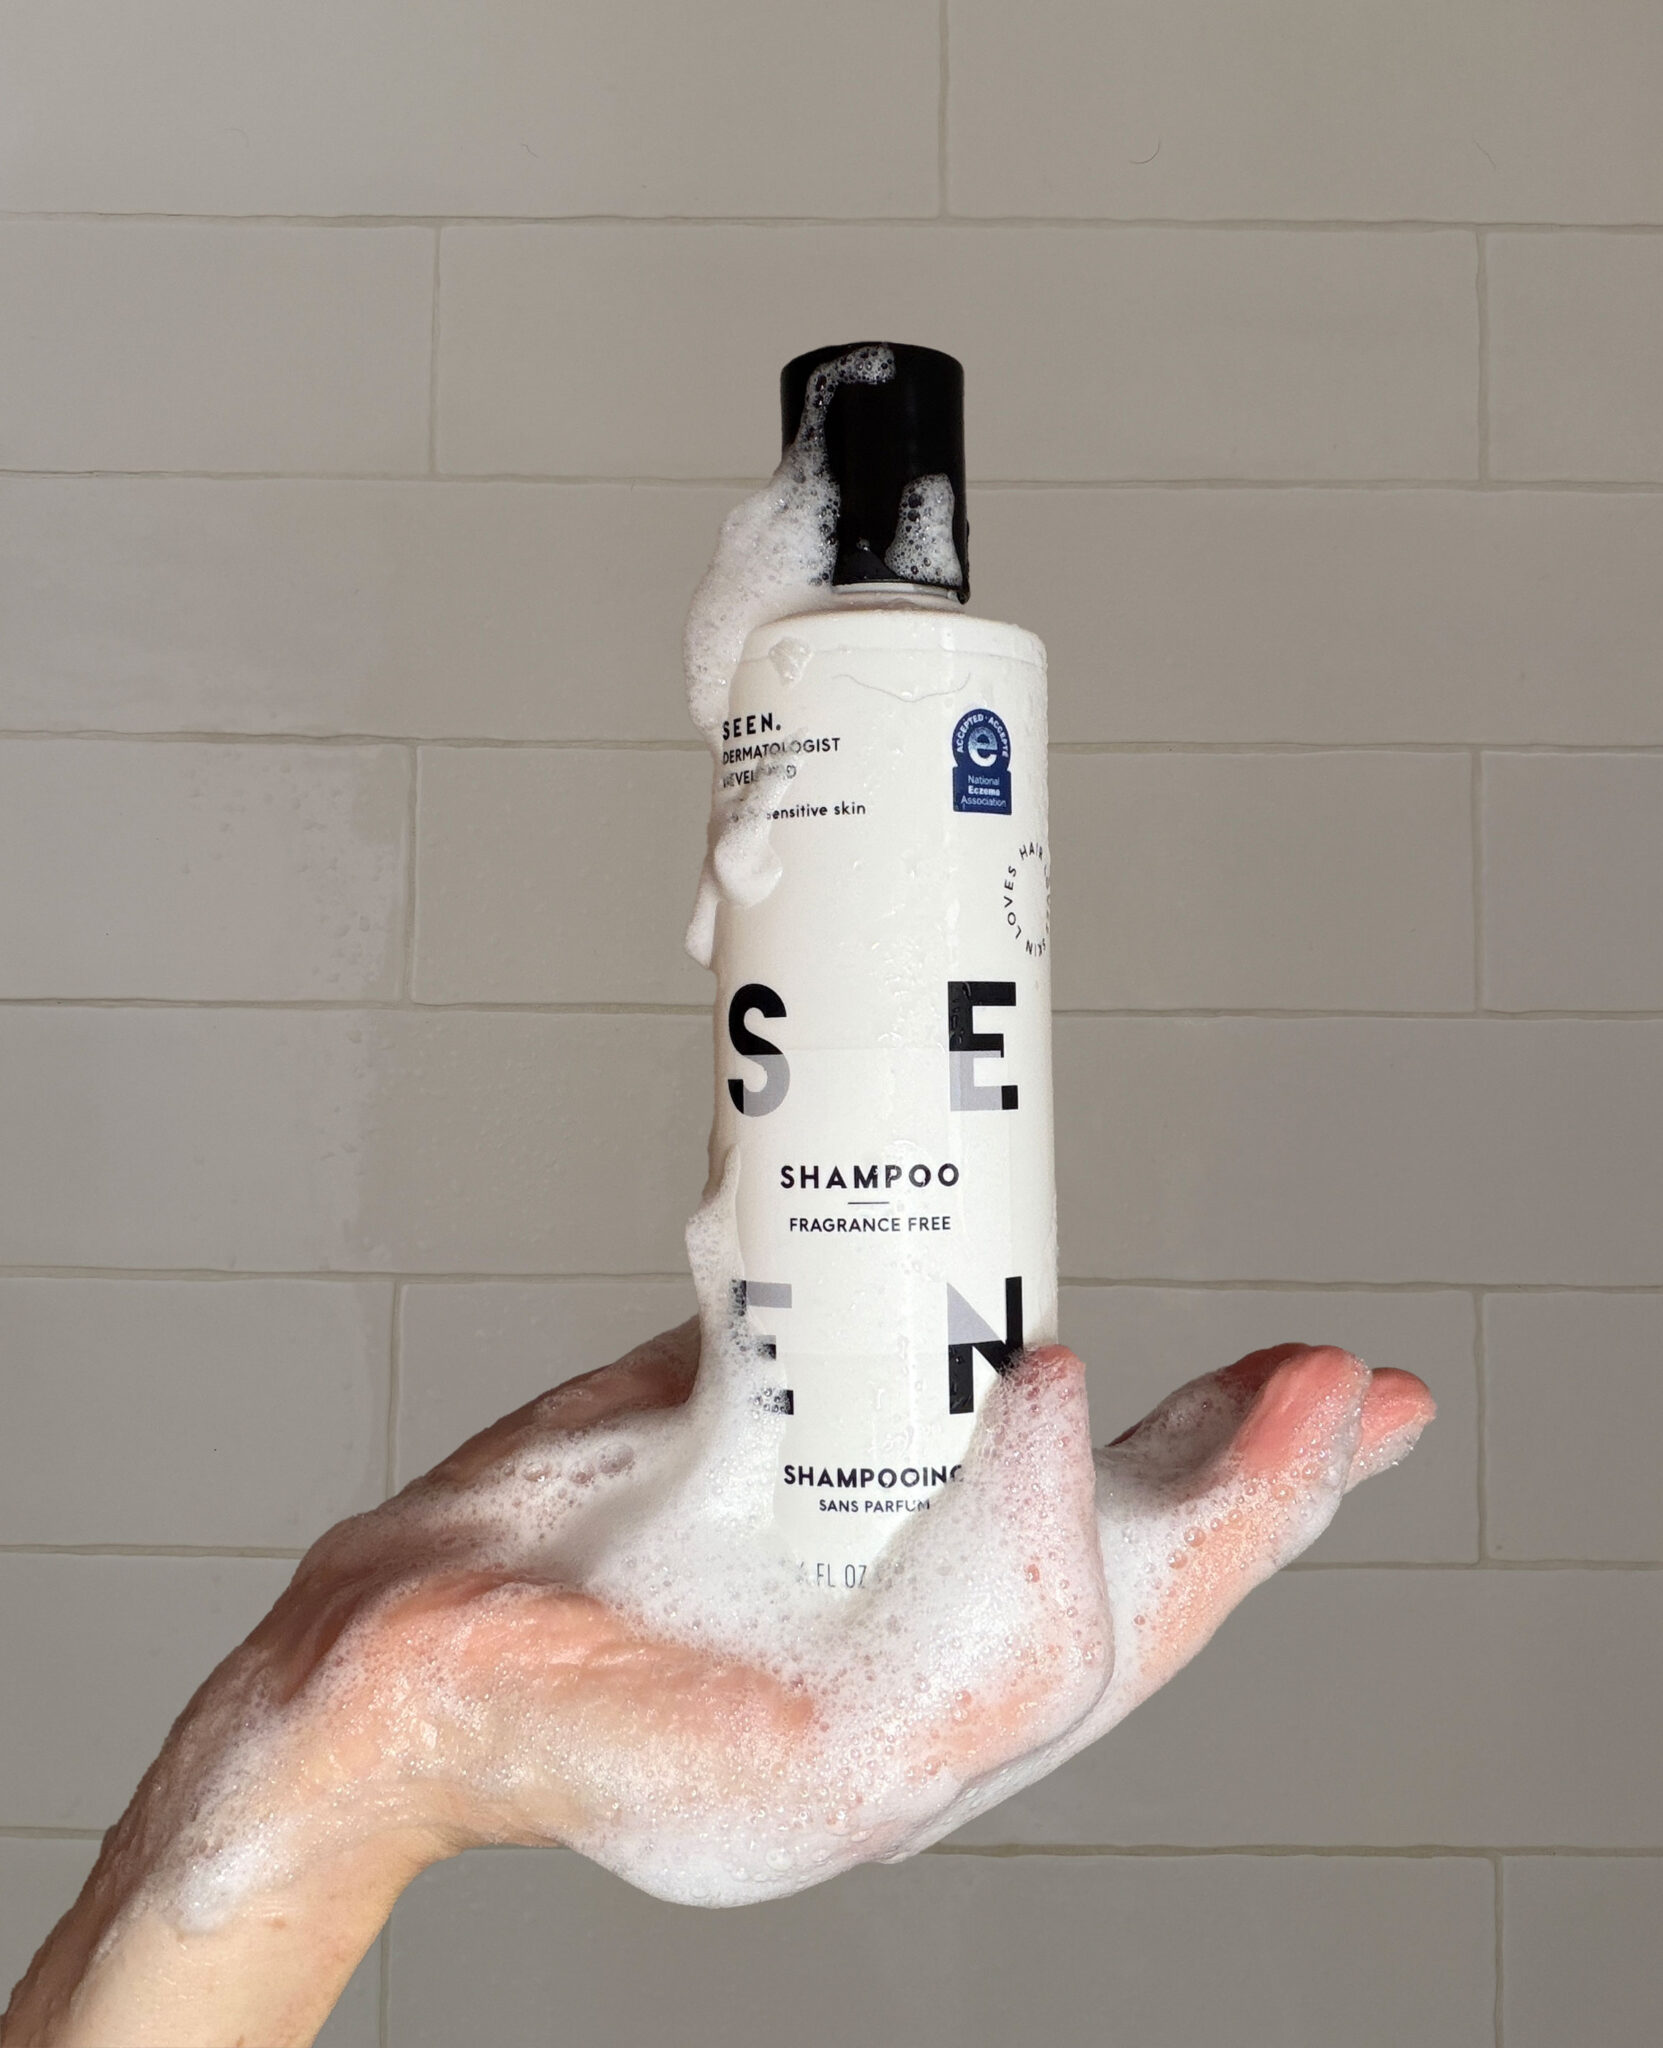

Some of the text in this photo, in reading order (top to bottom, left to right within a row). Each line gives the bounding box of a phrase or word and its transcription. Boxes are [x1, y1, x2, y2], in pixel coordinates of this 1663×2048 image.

[722, 712, 781, 740] SEEN.
[722, 737, 841, 765] DERMATOLOGIST
[967, 775, 1000, 786] National
[967, 785, 1000, 797] Eczema
[834, 800, 866, 815] skin
[960, 795, 1007, 808] Association
[727, 981, 1019, 1117] S E
[780, 1162, 960, 1189] SHAMPOO
[789, 1216, 951, 1232] FRAGRANCE FREE
[819, 1499, 930, 1513] SANS PARFUM
[816, 1562, 836, 1588] FL
